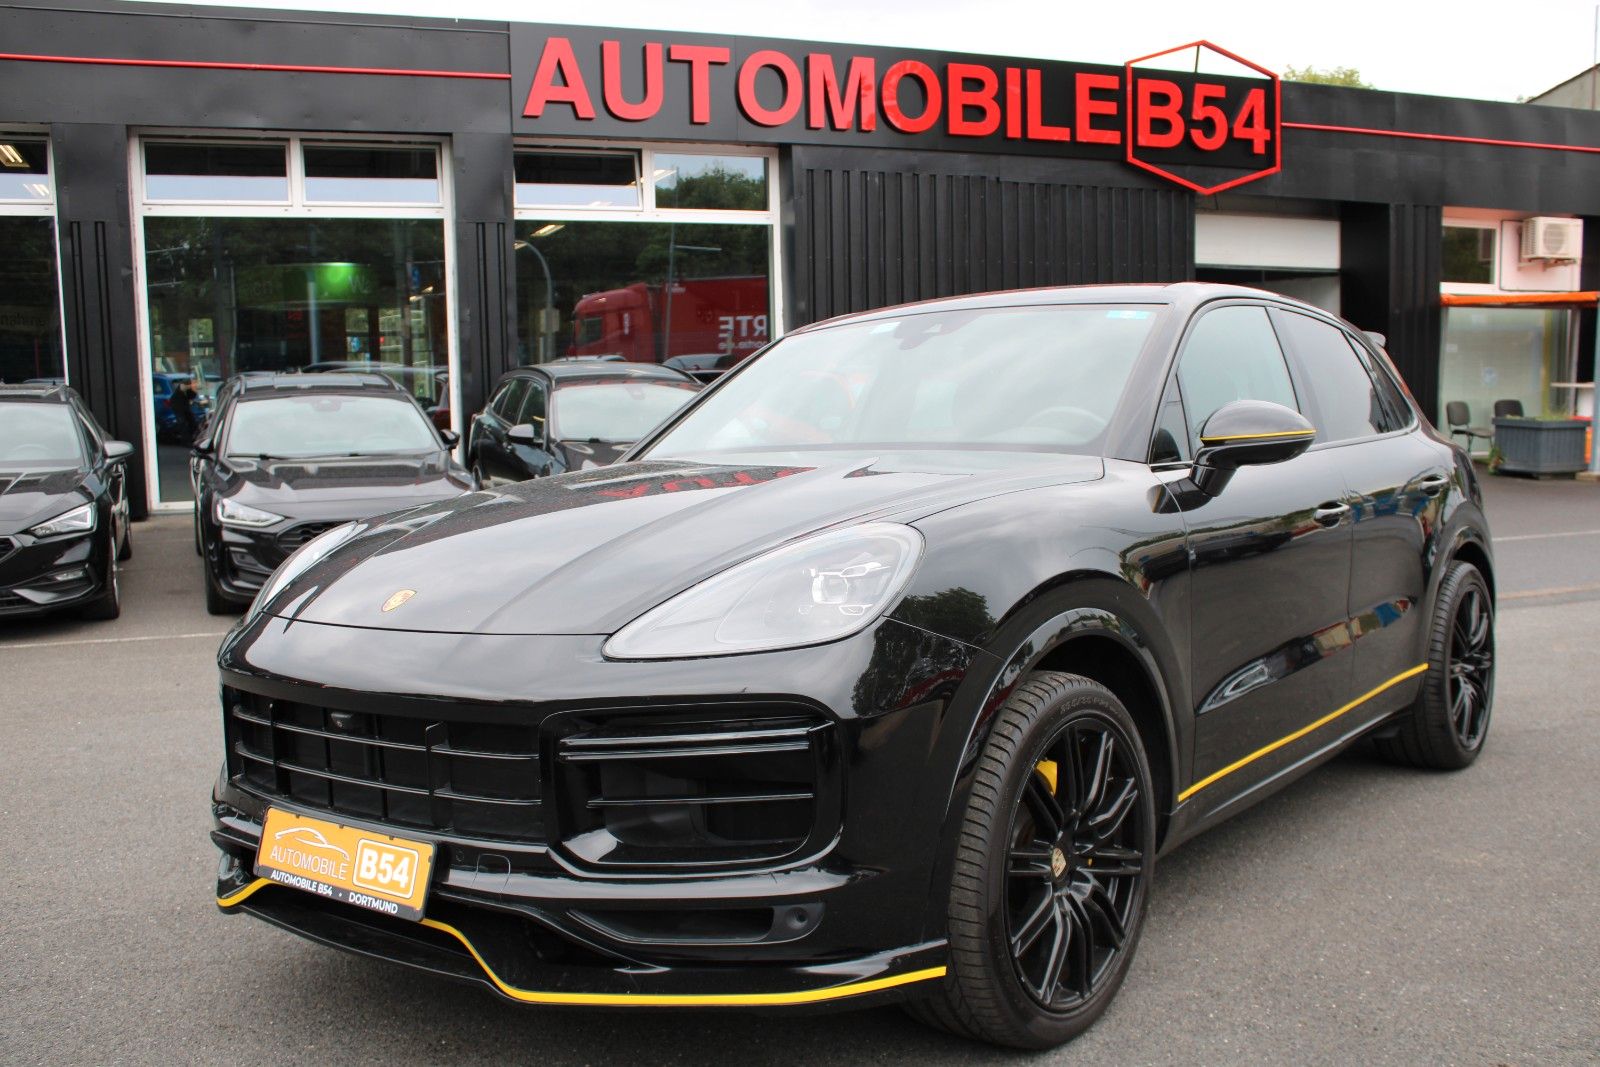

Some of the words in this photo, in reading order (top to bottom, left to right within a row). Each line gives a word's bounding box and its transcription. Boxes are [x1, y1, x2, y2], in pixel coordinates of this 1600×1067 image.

[522, 37, 1121, 145] AUTOMOBILE
[1135, 78, 1271, 155] B54
[270, 845, 349, 880] AUTOMOBILE
[359, 848, 409, 889] B54
[270, 869, 317, 892] AUTOMOBILE
[317, 884, 333, 896] B54
[348, 891, 398, 915] DORTMUND
